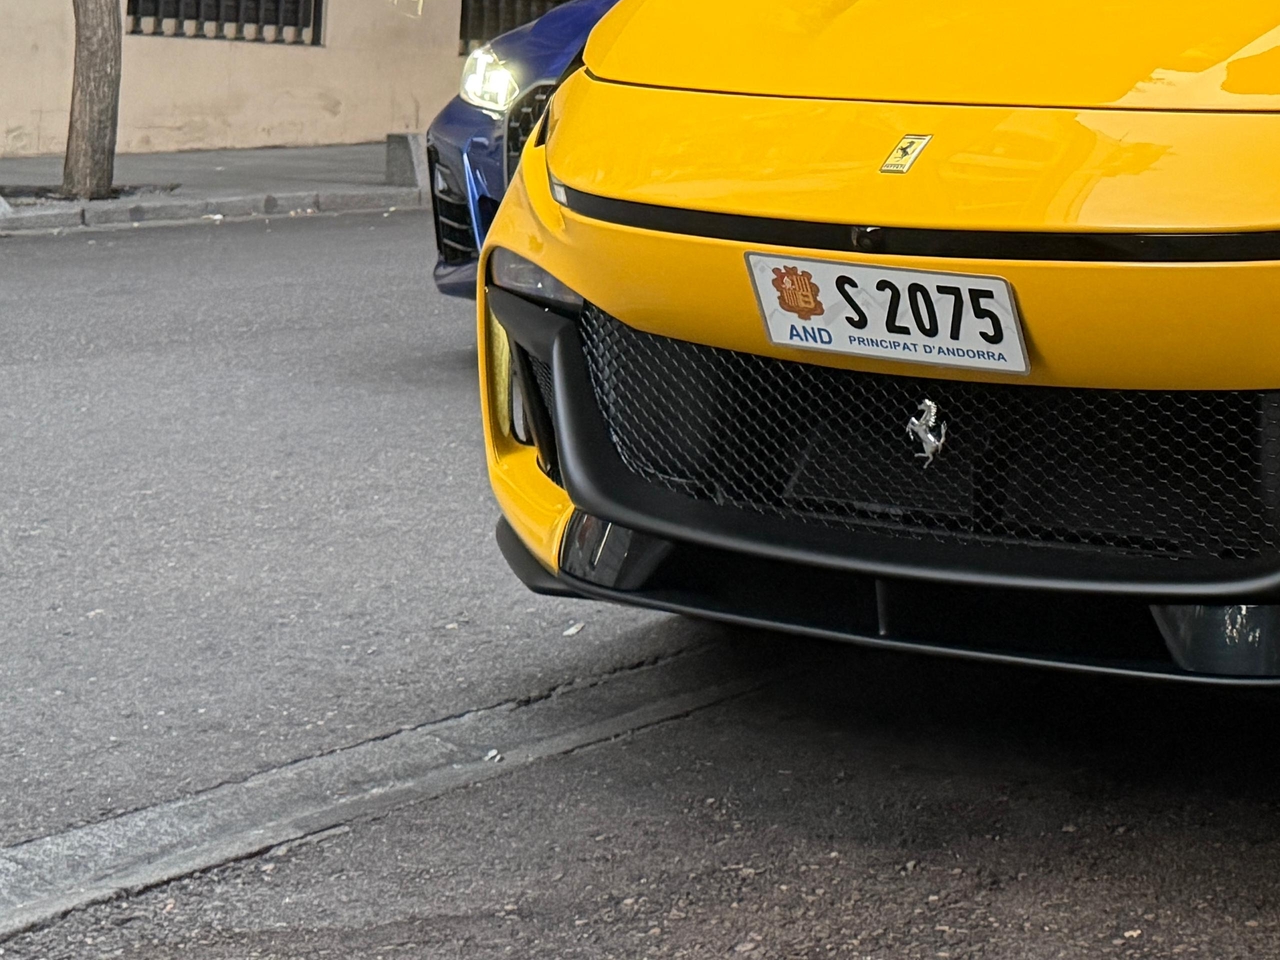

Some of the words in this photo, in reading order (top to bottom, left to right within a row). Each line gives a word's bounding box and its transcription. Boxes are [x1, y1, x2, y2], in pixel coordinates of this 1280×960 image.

[835, 274, 868, 330] S
[875, 278, 1004, 345] 2075
[788, 324, 833, 345] AND
[848, 335, 919, 354] PRINCIPAT
[923, 344, 1008, 363] D'ANDORRA
